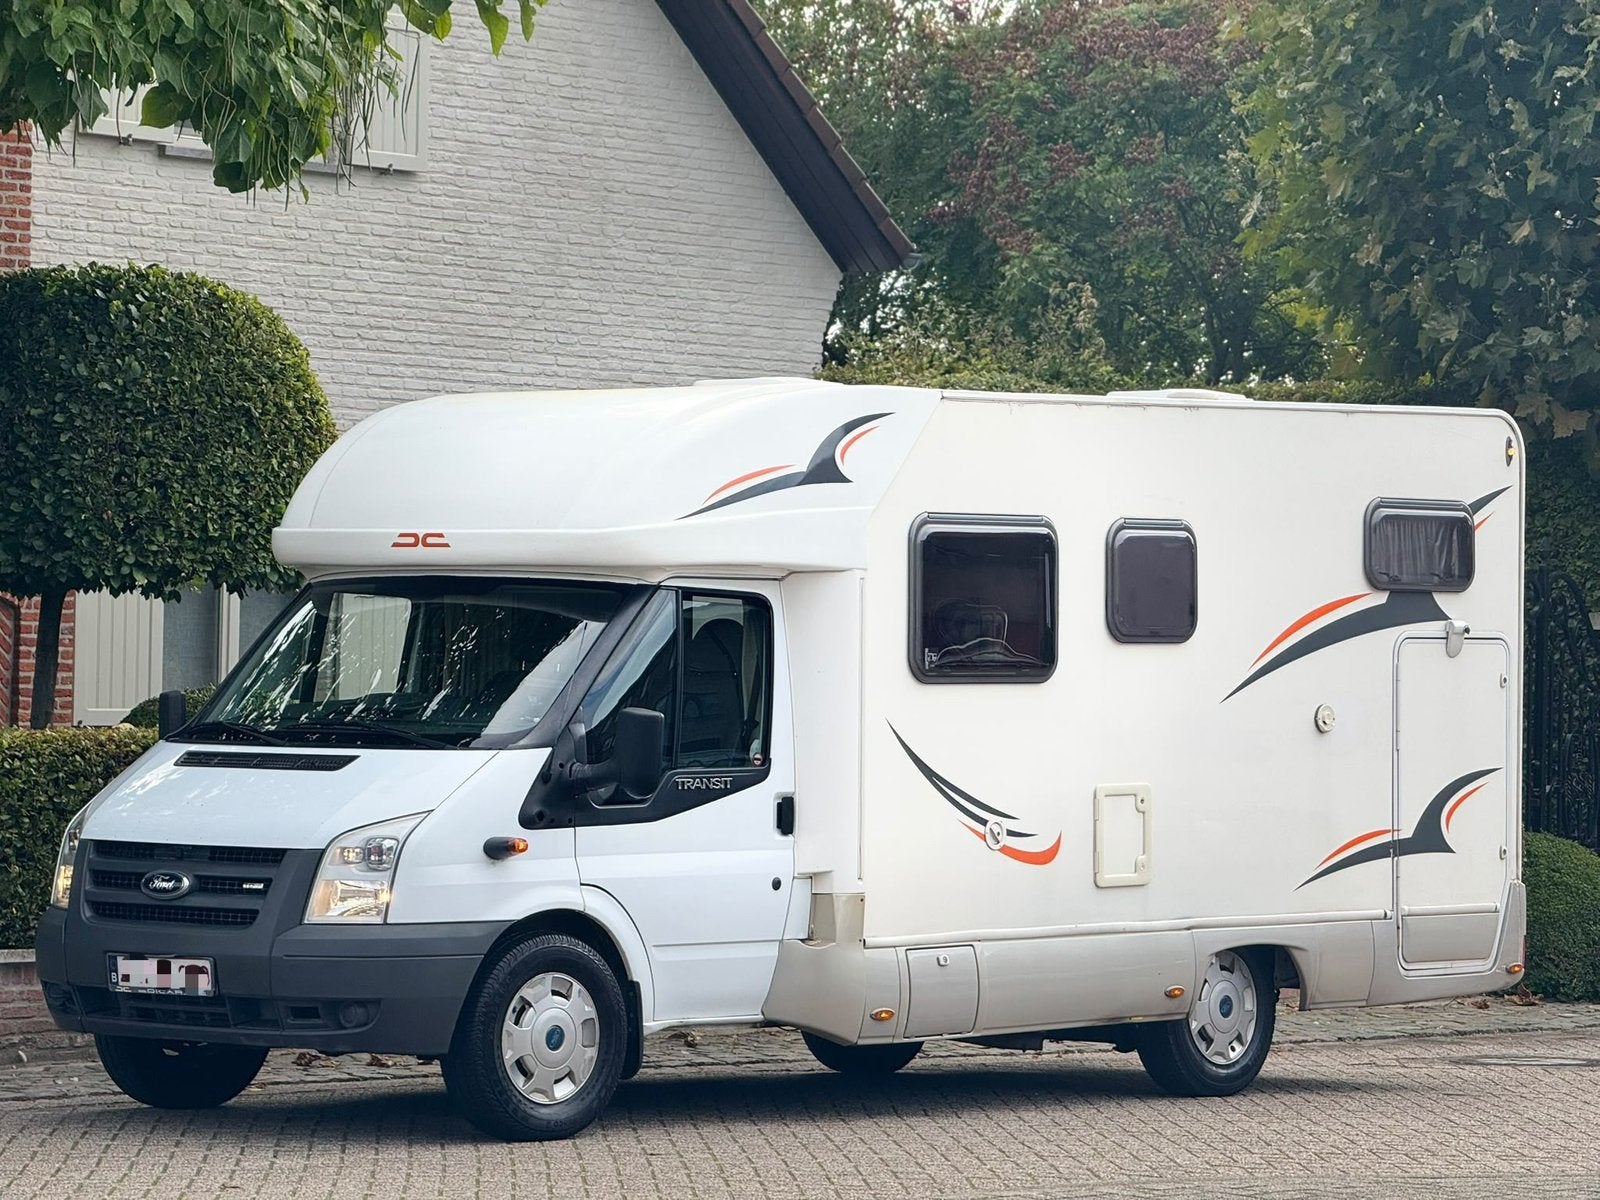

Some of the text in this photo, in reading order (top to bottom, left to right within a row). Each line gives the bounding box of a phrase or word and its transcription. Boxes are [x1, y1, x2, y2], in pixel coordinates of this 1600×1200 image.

[675, 777, 733, 790] TRANSIT
[148, 874, 176, 890] Ford
[111, 972, 118, 983] B
